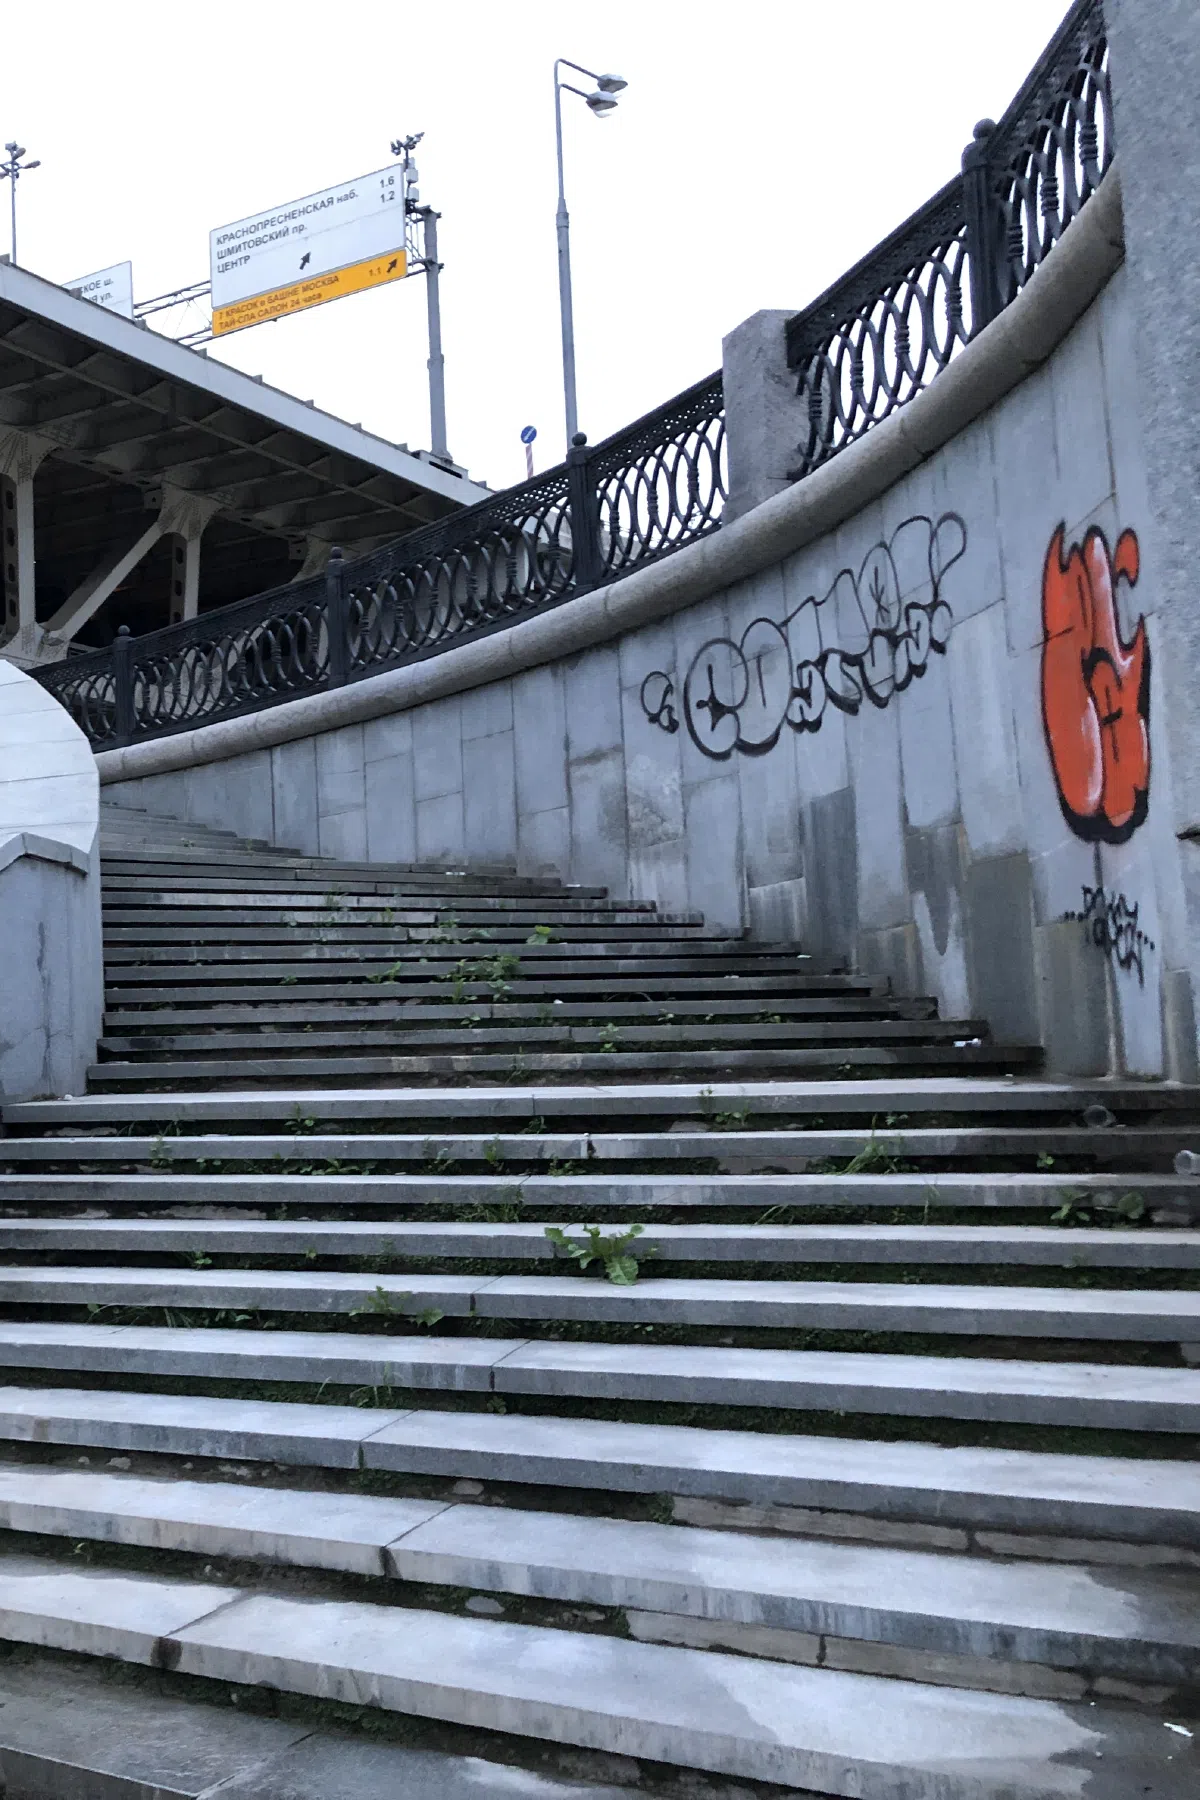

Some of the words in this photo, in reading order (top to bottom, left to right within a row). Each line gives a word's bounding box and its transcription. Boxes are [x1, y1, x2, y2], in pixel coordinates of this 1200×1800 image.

[216, 196, 334, 245] КРАСНОПРЕСНЕНСКАЯ
[336, 188, 359, 205] наб.
[379, 175, 395, 189] 1.6
[216, 226, 289, 260] ШМИТОВСКИЙ
[291, 223, 307, 237] пр.
[379, 190, 395, 204] 1.2
[217, 254, 251, 274] ЦЕНТР
[218, 311, 256, 331] ТАЙ-СПА
[257, 303, 289, 319] САЛОН
[290, 297, 301, 309] 24
[225, 300, 259, 318] КРАСОК
[267, 286, 300, 305] БАШНЕ
[301, 275, 340, 295] МОСКВА
[368, 266, 382, 278] 1.1
